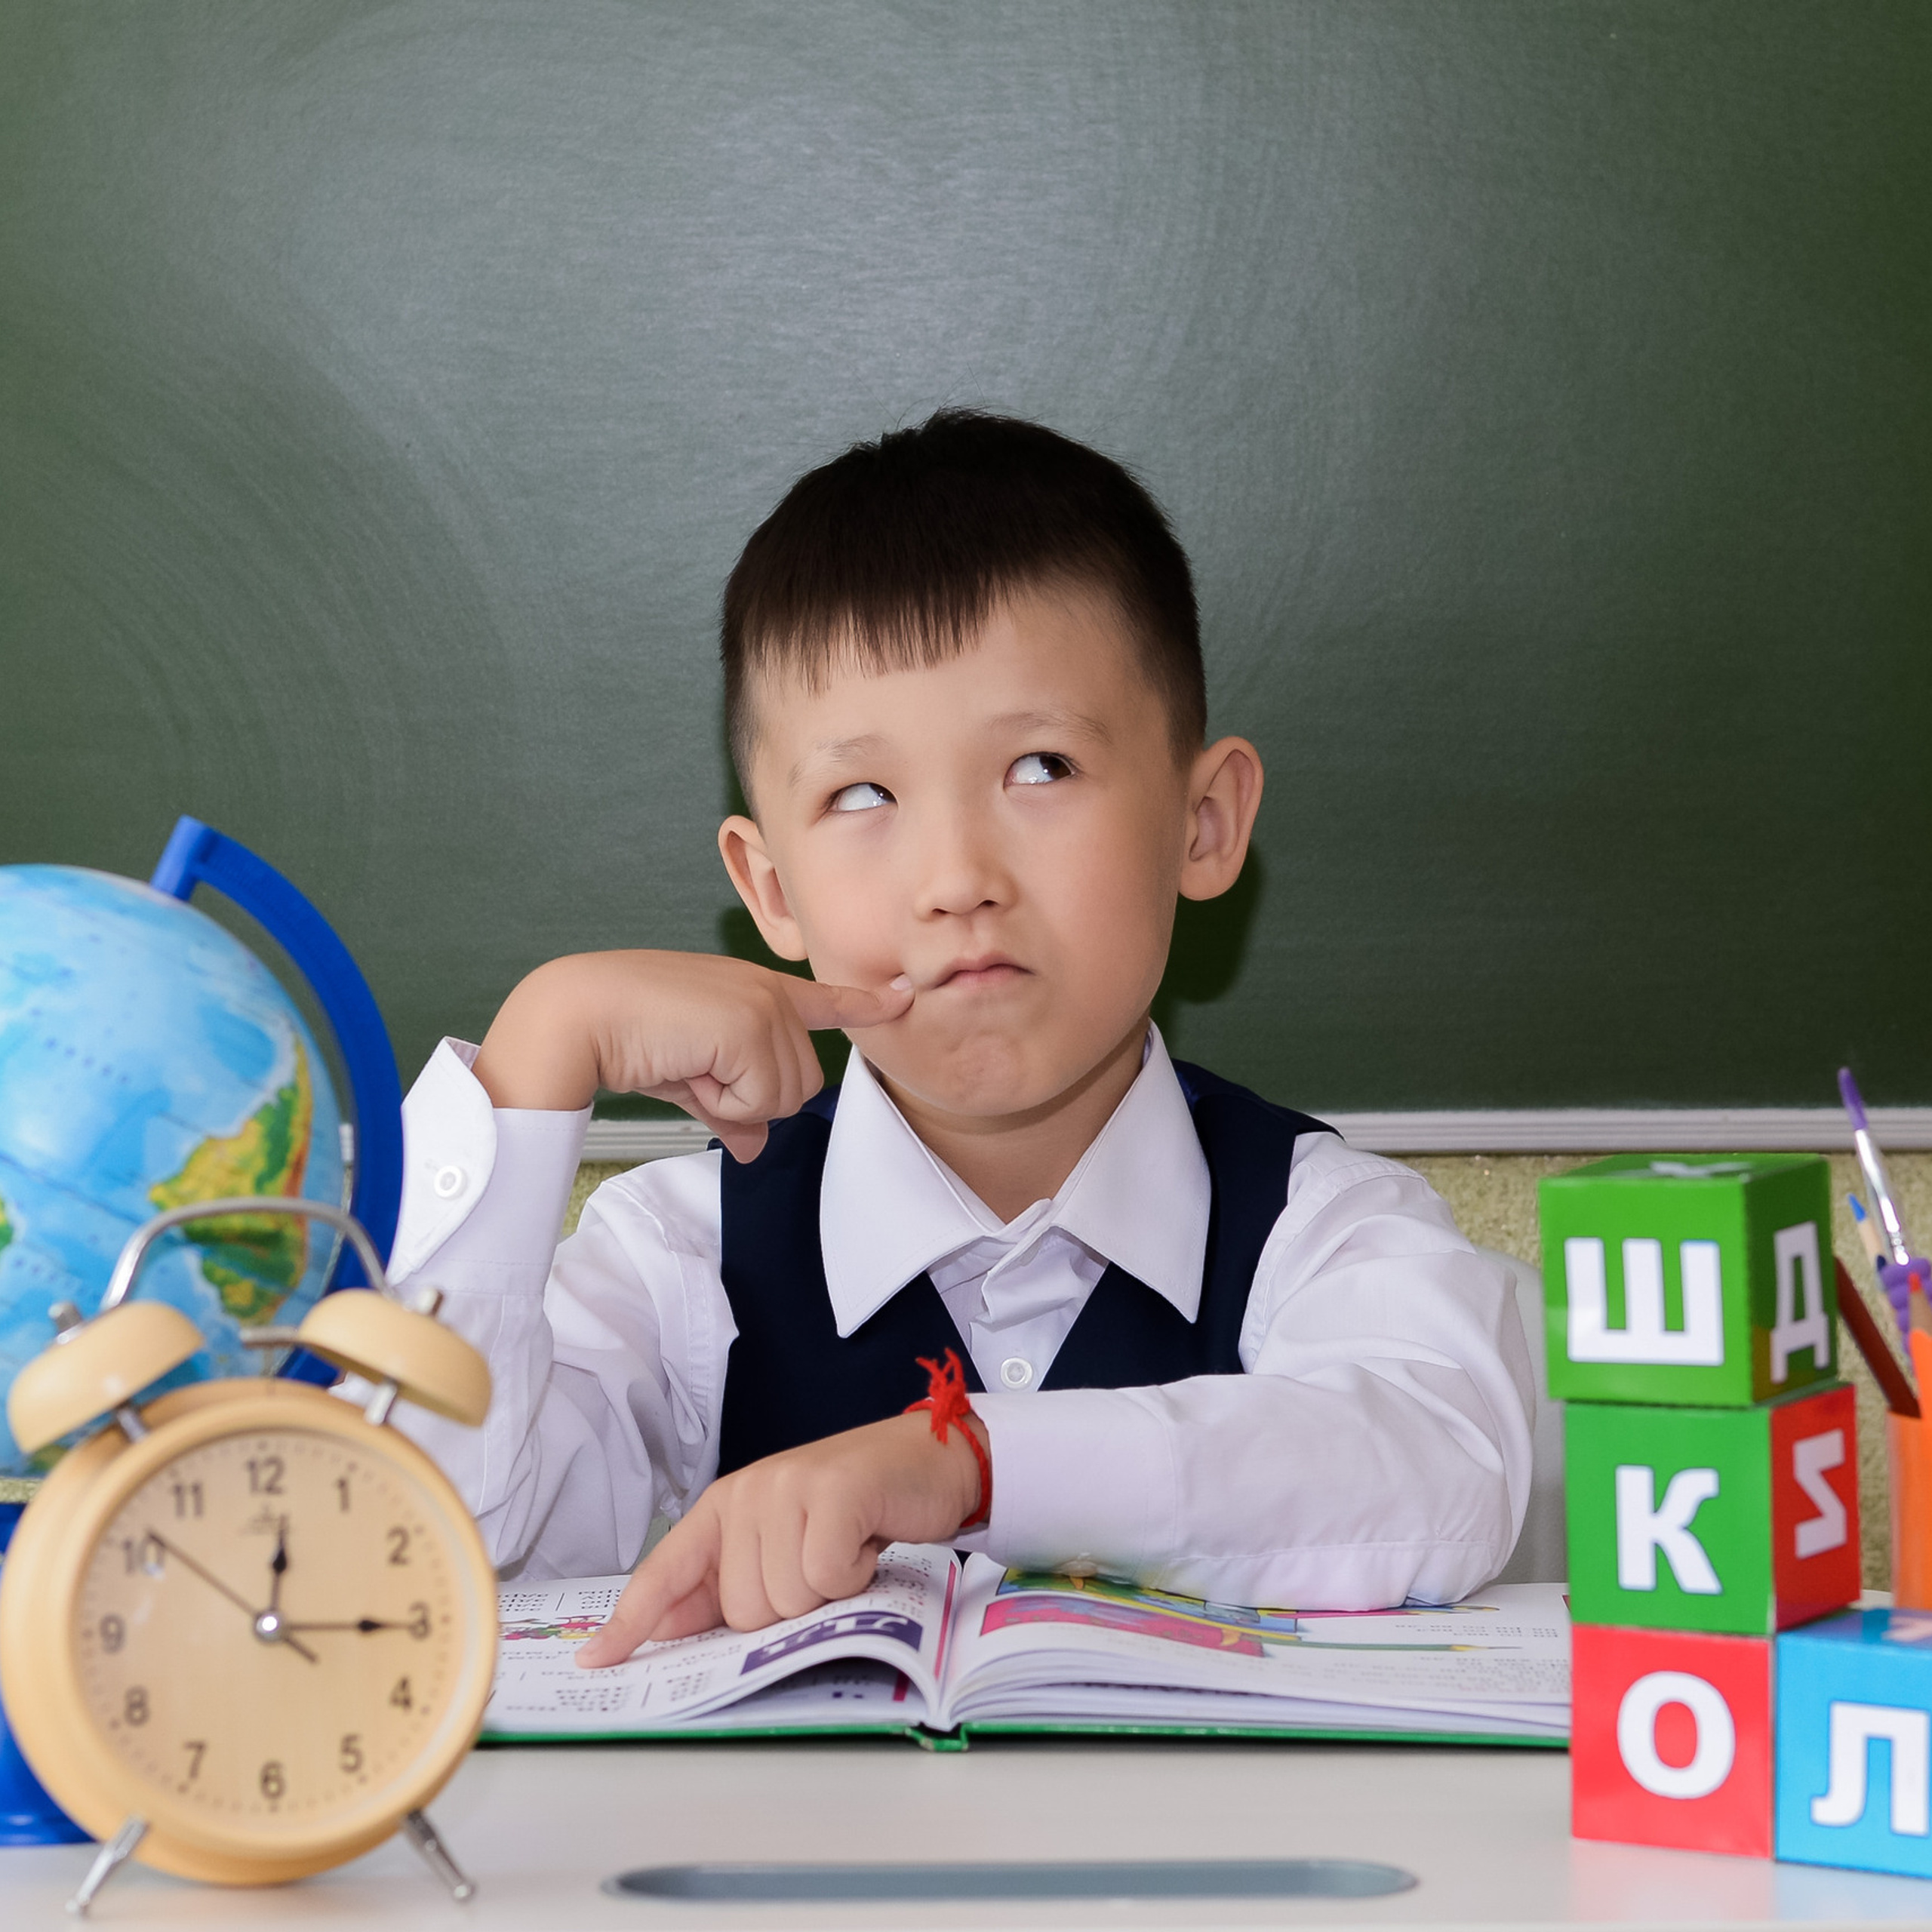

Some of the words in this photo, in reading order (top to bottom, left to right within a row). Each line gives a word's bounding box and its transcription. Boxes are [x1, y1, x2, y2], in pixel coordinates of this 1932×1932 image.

[1564, 1237, 1724, 1367] Ш
[1770, 1221, 1829, 1383] Д
[246, 1456, 285, 1495] 12
[335, 1478, 351, 1512] 1
[172, 1483, 205, 1518] 11
[387, 1527, 411, 1566] 2
[1616, 1465, 1723, 1595] К
[123, 1535, 165, 1575] 10
[100, 1616, 125, 1654] 9
[408, 1601, 431, 1640] 3
[124, 1686, 149, 1726] 8
[389, 1677, 413, 1712] 4
[340, 1734, 364, 1774] 5
[1617, 1670, 1736, 1799] О
[183, 1741, 208, 1780] 7
[1810, 1700, 1930, 1836] Л
[260, 1761, 285, 1800] 6
